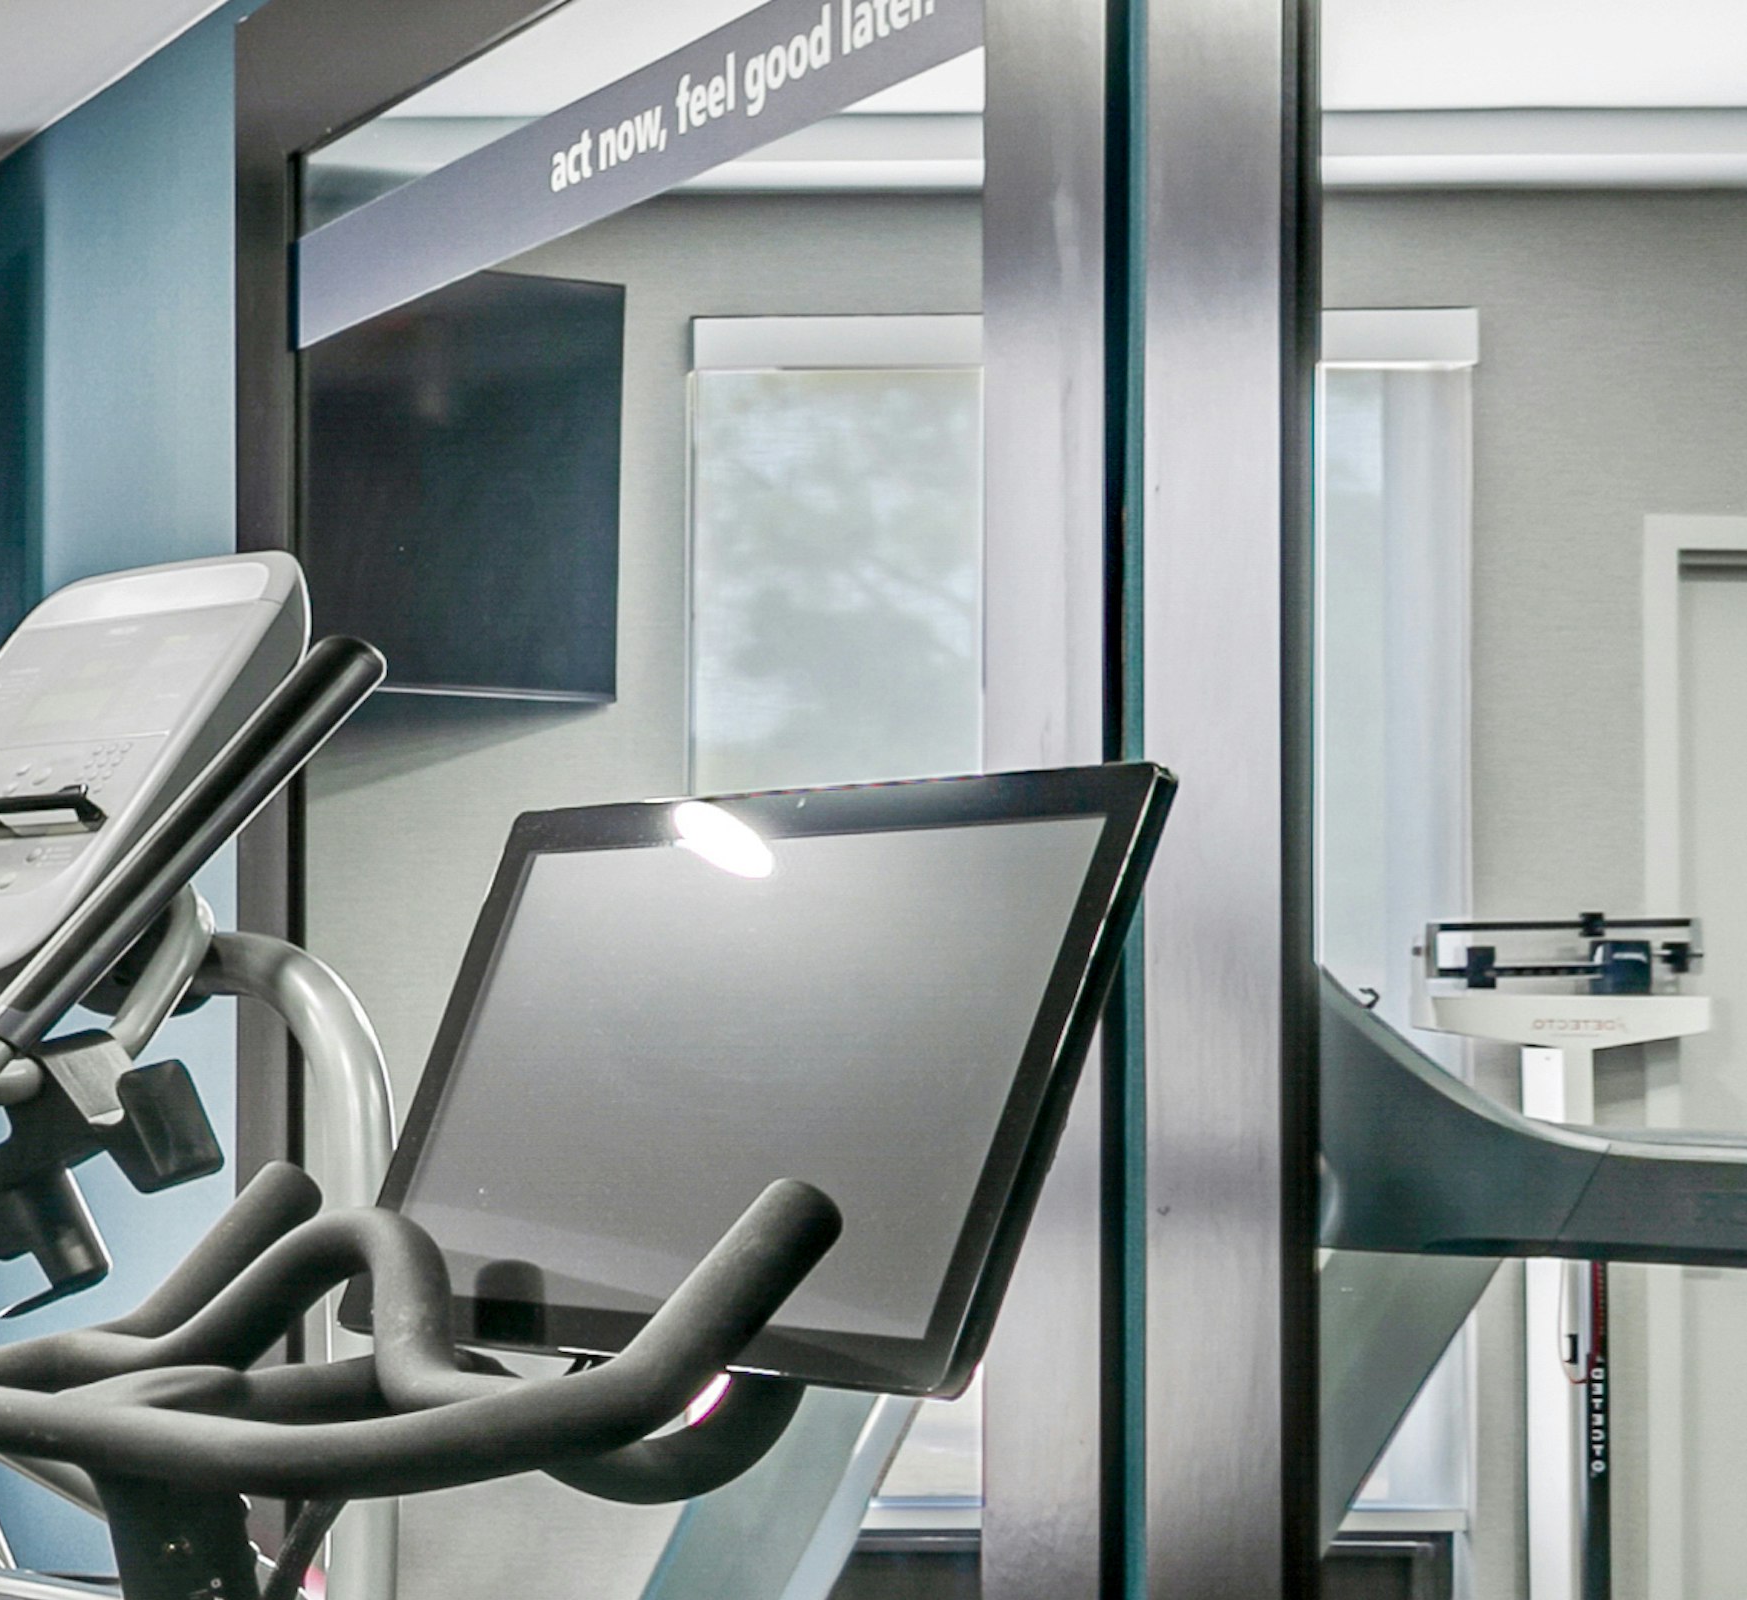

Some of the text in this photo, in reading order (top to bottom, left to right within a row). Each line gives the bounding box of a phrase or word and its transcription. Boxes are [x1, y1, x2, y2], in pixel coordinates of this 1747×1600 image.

[549, 128, 593, 193] act
[599, 105, 668, 171] now,
[675, 51, 736, 135] feel
[744, 3, 832, 118] good
